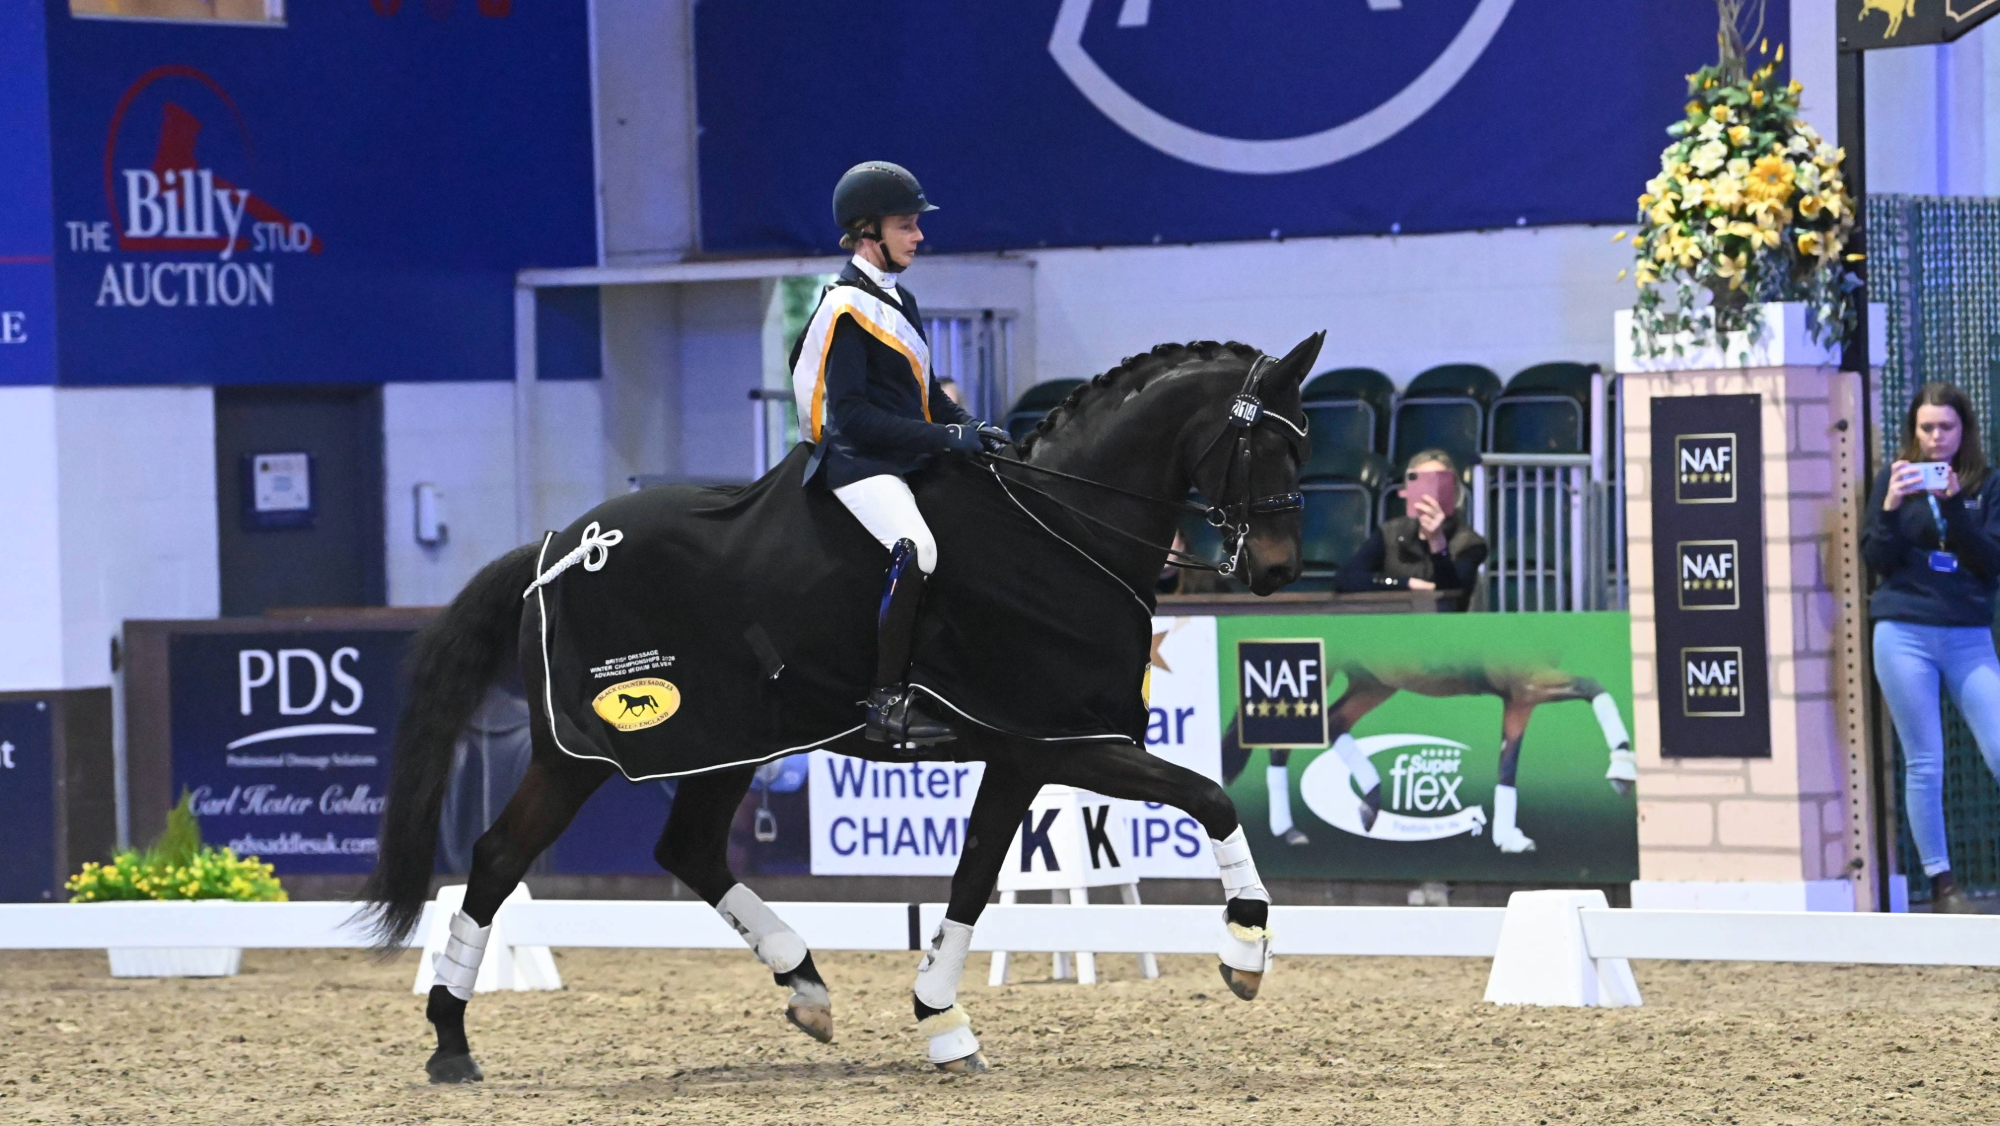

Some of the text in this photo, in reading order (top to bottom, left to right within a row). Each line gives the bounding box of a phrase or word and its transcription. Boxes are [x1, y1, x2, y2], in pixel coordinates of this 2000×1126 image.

[66, 168, 312, 260] THE Billy STUD
[96, 262, 275, 306] AUCTION
[0, 311, 27, 344] E
[1230, 400, 1257, 421] 214
[1680, 446, 1732, 473] NAF
[1682, 553, 1733, 580] NAF
[590, 663, 613, 674] WINTER
[614, 656, 660, 670] CHAMPIONSHIPS
[594, 661, 672, 679] ADVANCED MEDIUM SILVER
[605, 649, 659, 666] BRITISH DRESSAGE
[1687, 660, 1737, 686] NAF
[238, 646, 364, 717] PDS
[597, 679, 674, 702] BLACK COUNTRY SADDLES
[1243, 658, 1318, 699] NAF
[639, 711, 669, 728] ENGLAND
[1145, 706, 1195, 745] ar
[0, 740, 15, 769] t
[1411, 754, 1462, 776] Super
[827, 758, 969, 798] Winter
[1389, 754, 1463, 811] flex
[188, 785, 242, 816] Carl
[239, 784, 313, 816] Hester
[1020, 808, 1062, 873] K
[1082, 805, 1121, 869] K
[1131, 817, 1201, 858] IPS
